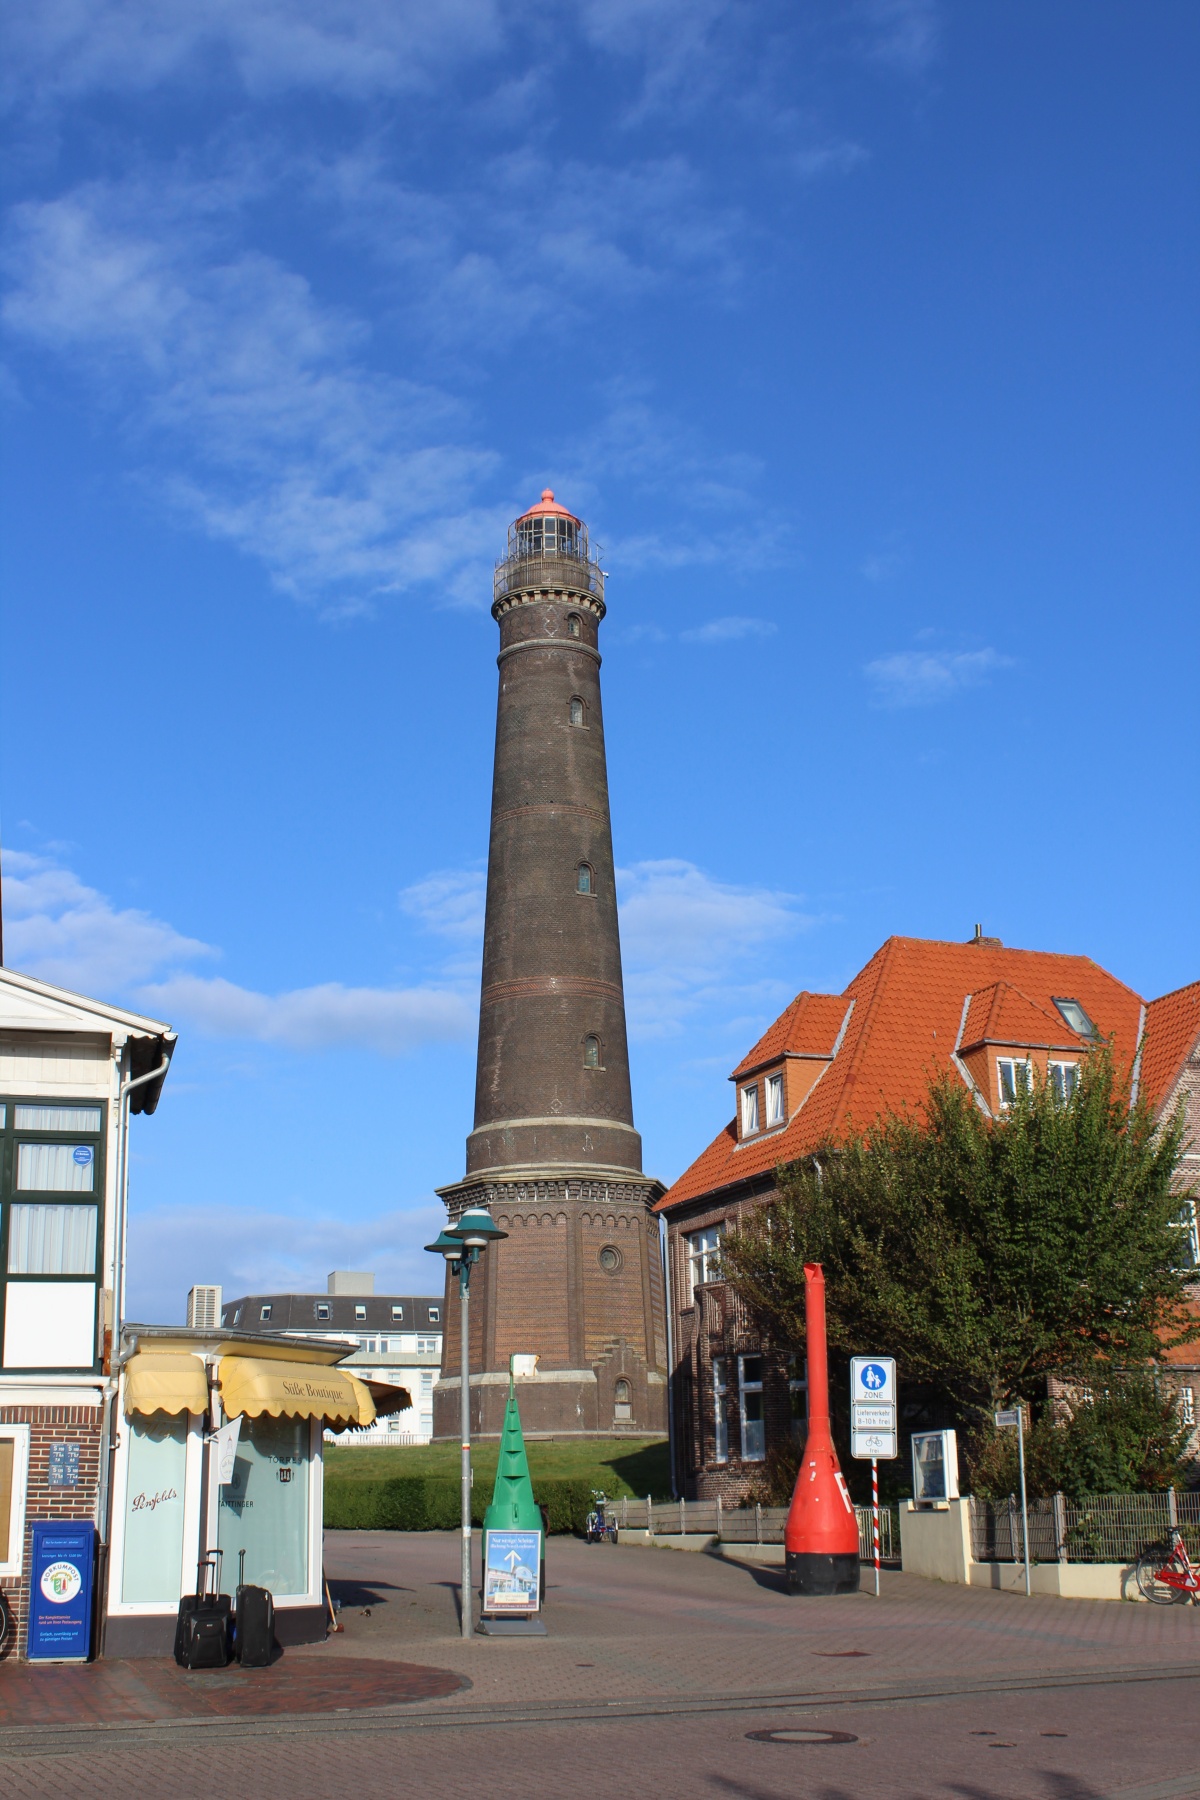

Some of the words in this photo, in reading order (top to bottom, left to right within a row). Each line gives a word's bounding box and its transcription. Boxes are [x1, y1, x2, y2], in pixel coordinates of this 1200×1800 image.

[283, 1381, 305, 1396] Süße
[306, 1383, 344, 1403] Boutique
[864, 1391, 884, 1399] ZONE
[268, 1456, 303, 1464] TORRES
[131, 1488, 177, 1512] Penfolds
[44, 1564, 79, 1582] BORKUMPOST
